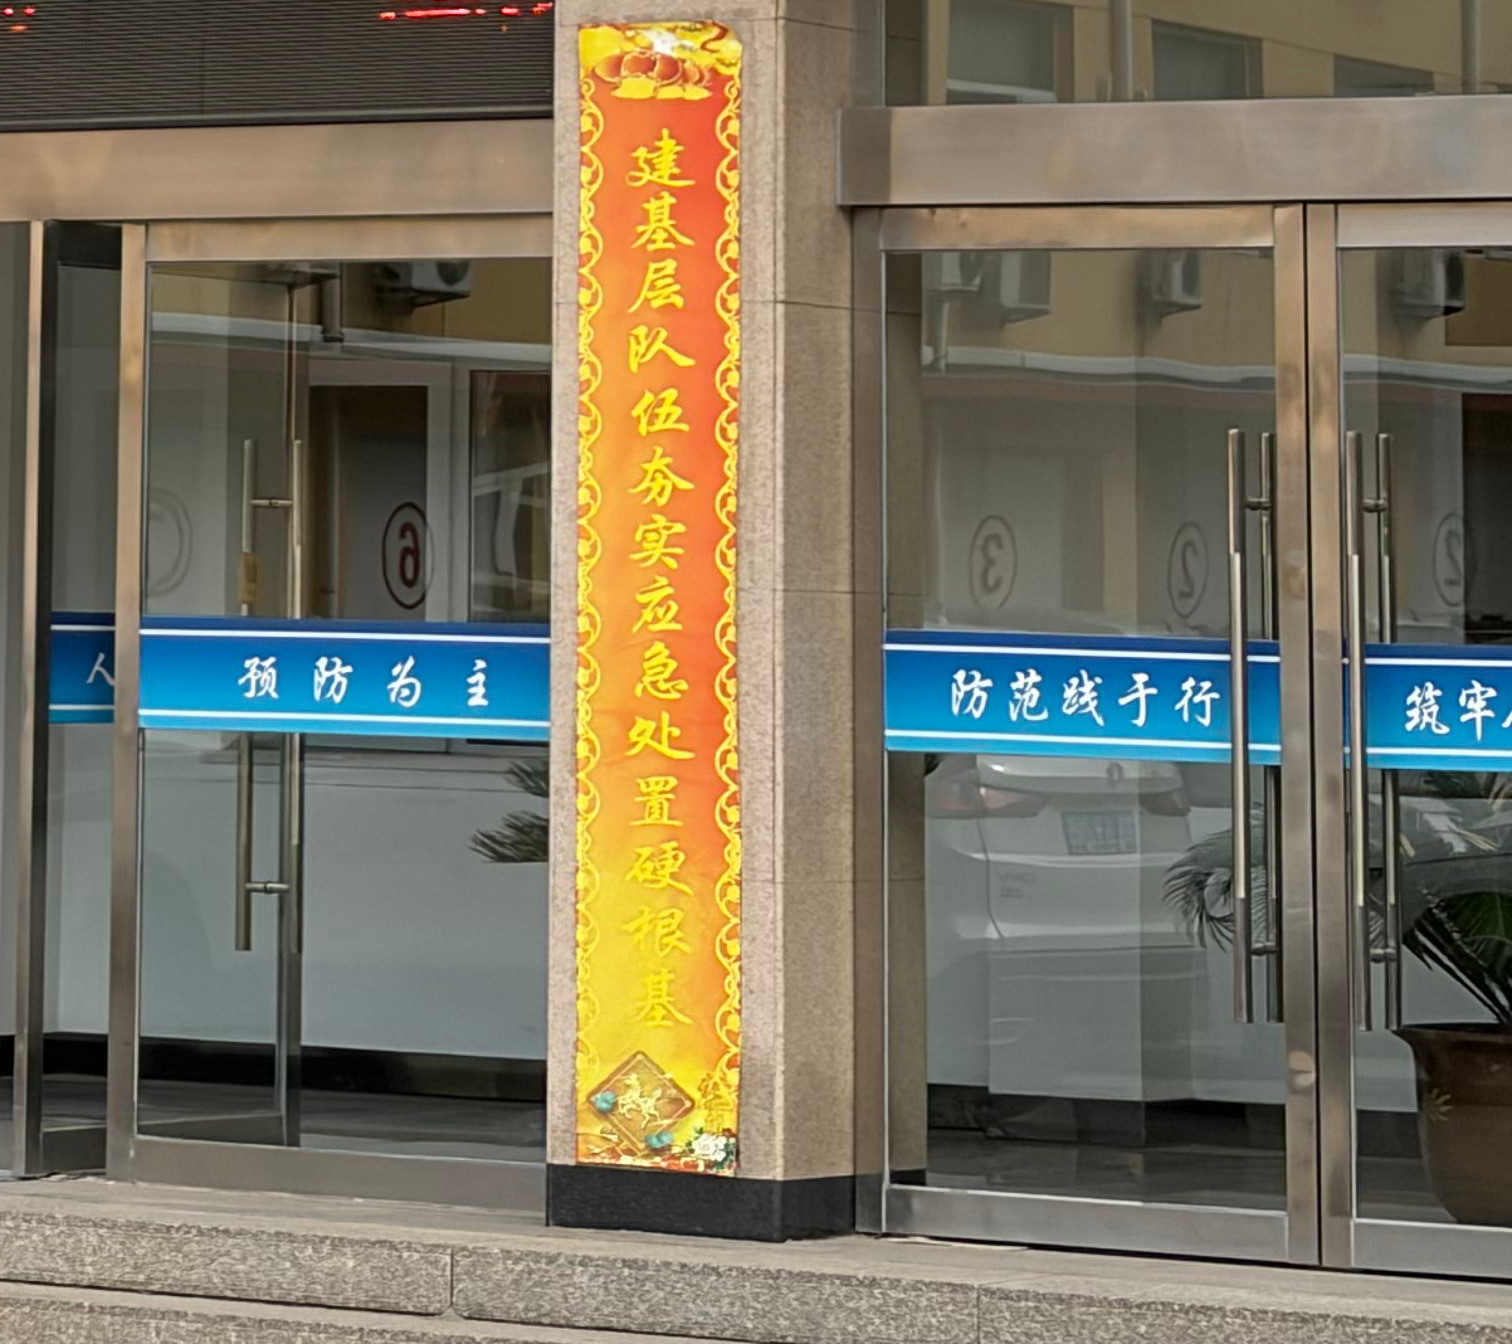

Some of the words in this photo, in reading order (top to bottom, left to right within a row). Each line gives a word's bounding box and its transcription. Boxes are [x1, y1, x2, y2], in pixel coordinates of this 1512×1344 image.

[621, 127, 696, 1029] 建基层队伍夯实应急处置硬根基
[237, 655, 490, 709] 预防为主
[951, 668, 1221, 728] 防范践于行
[1404, 679, 1512, 742] 筑牢
